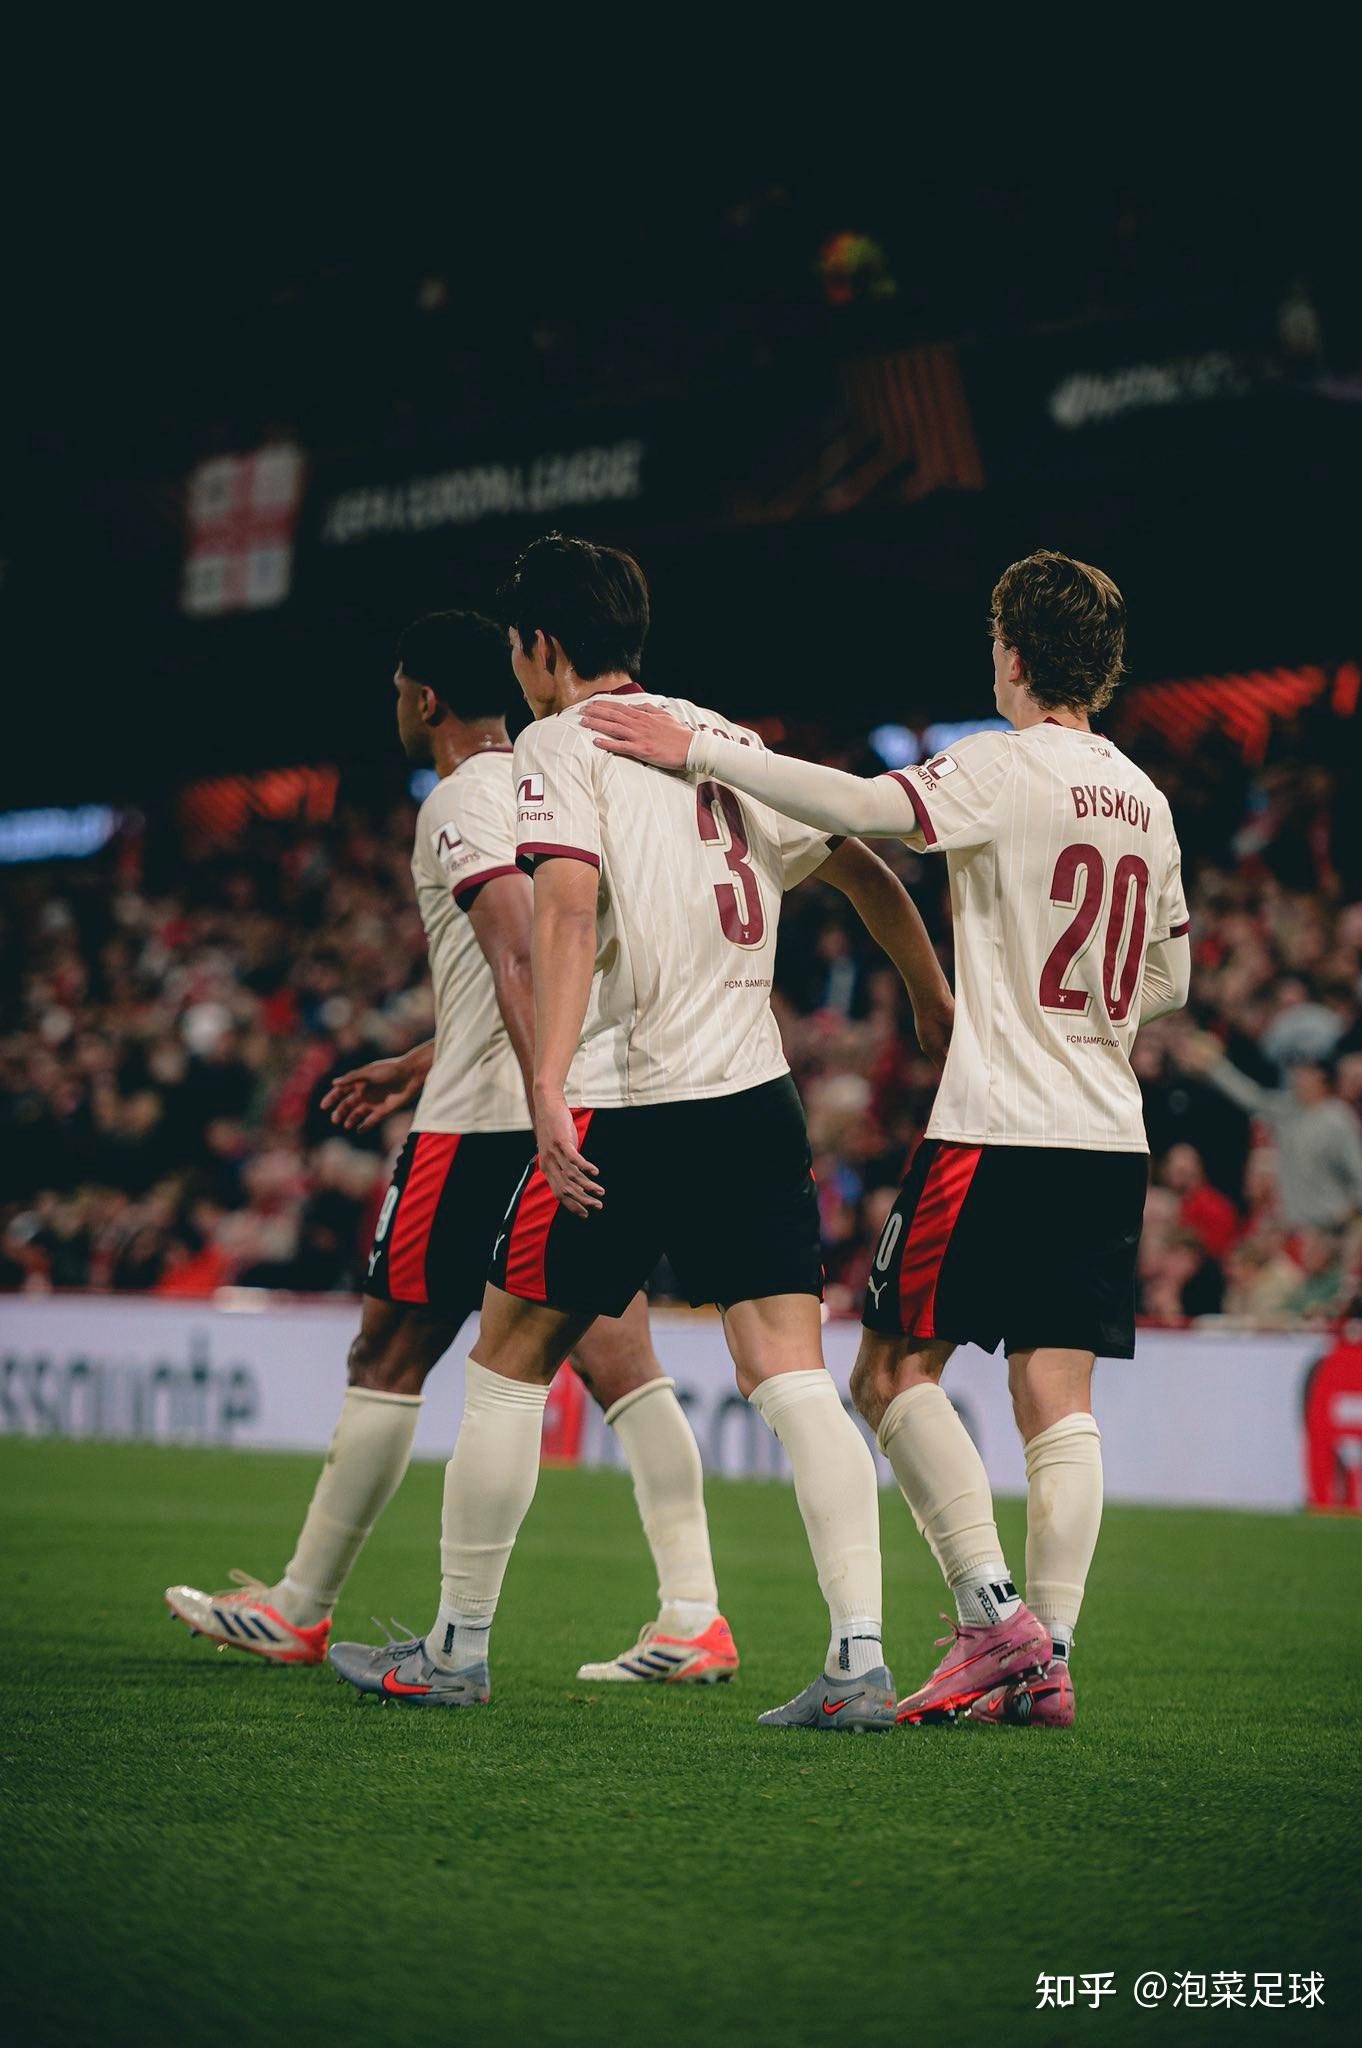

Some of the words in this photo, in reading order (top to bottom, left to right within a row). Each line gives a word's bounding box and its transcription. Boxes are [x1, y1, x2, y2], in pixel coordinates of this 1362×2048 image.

[1071, 785, 1151, 833] BYSKOV
[696, 780, 766, 948] 3
[1040, 843, 1150, 1023] 20
[724, 980, 743, 990] FCM
[1066, 1035, 1082, 1043] FCM
[1083, 1036, 1120, 1048] SAMFUND
